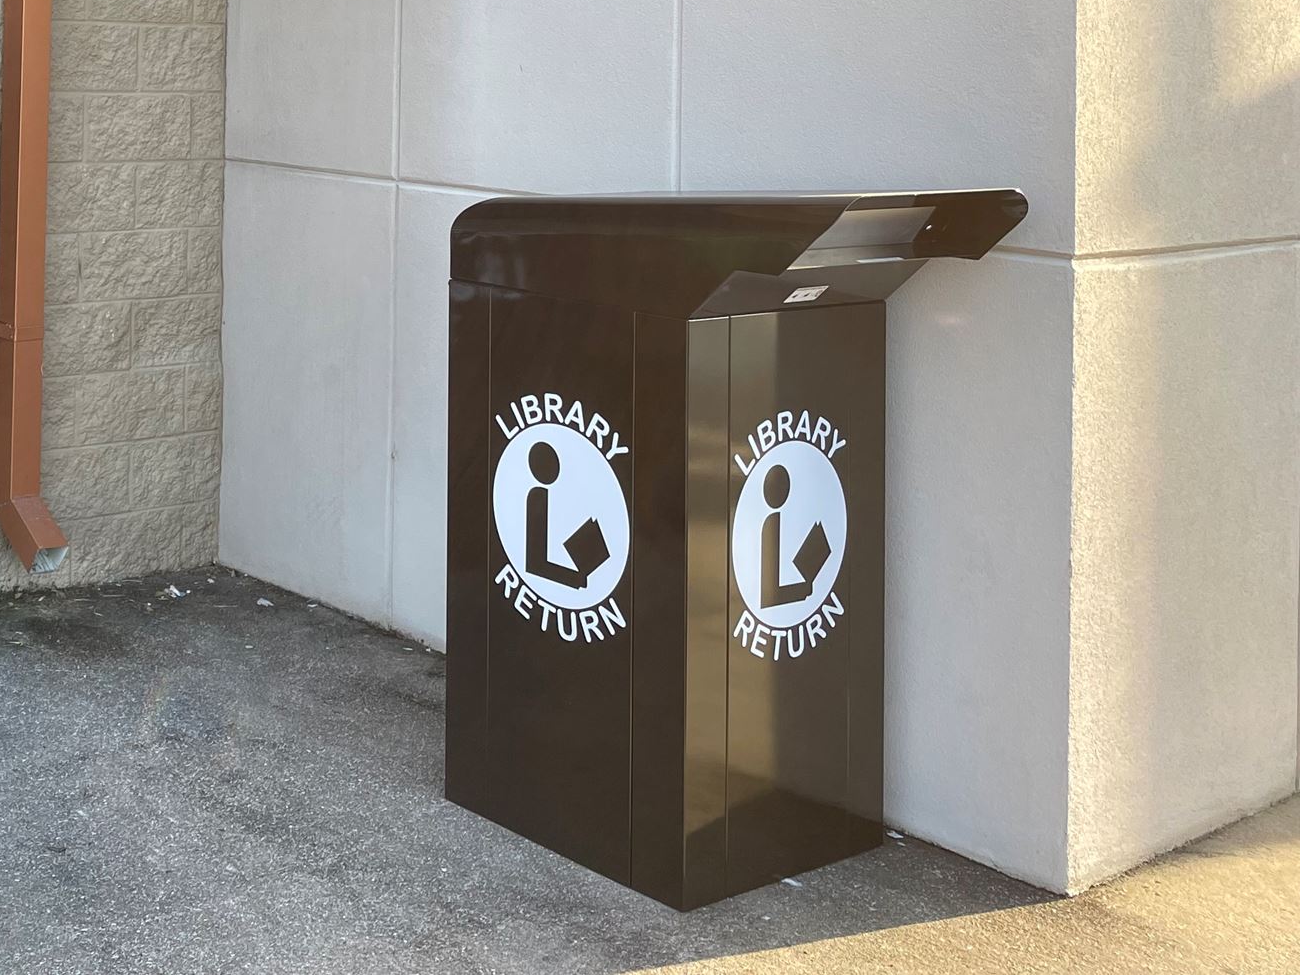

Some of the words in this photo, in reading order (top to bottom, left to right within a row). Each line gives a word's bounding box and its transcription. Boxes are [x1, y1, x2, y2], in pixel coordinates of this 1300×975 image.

[494, 393, 628, 461] LIBRARY
[734, 410, 846, 477] LIBRARY
[494, 563, 628, 643] RETURN
[732, 590, 845, 661] RETURN
